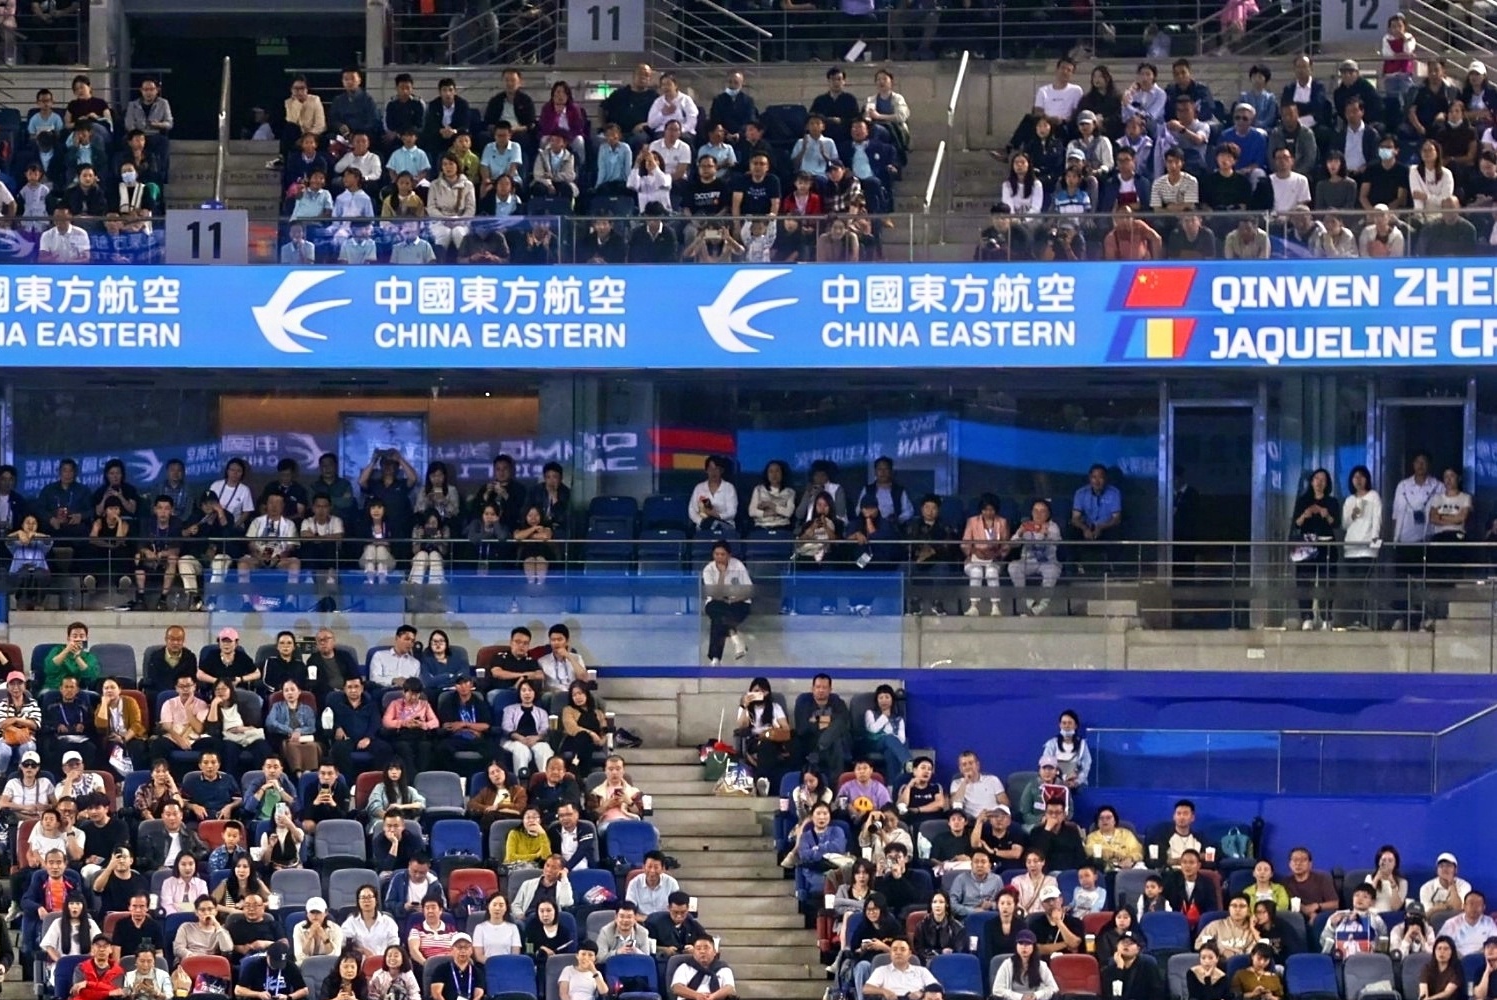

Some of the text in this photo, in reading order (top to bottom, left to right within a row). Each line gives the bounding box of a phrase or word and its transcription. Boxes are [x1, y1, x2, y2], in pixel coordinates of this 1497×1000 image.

[587, 5, 620, 41] 11
[1341, 0, 1380, 30] 12
[187, 221, 222, 259] 11
[375, 275, 626, 315] 中國東方航空
[822, 273, 1076, 315] 中國東方航空
[1211, 267, 1497, 314] QINWEN ZHE
[37, 321, 181, 348] EASTERN
[375, 322, 626, 349] CHINA EASTERN
[822, 321, 1076, 348] CHINA EASTERN
[1210, 326, 1438, 365] JAQUELINE
